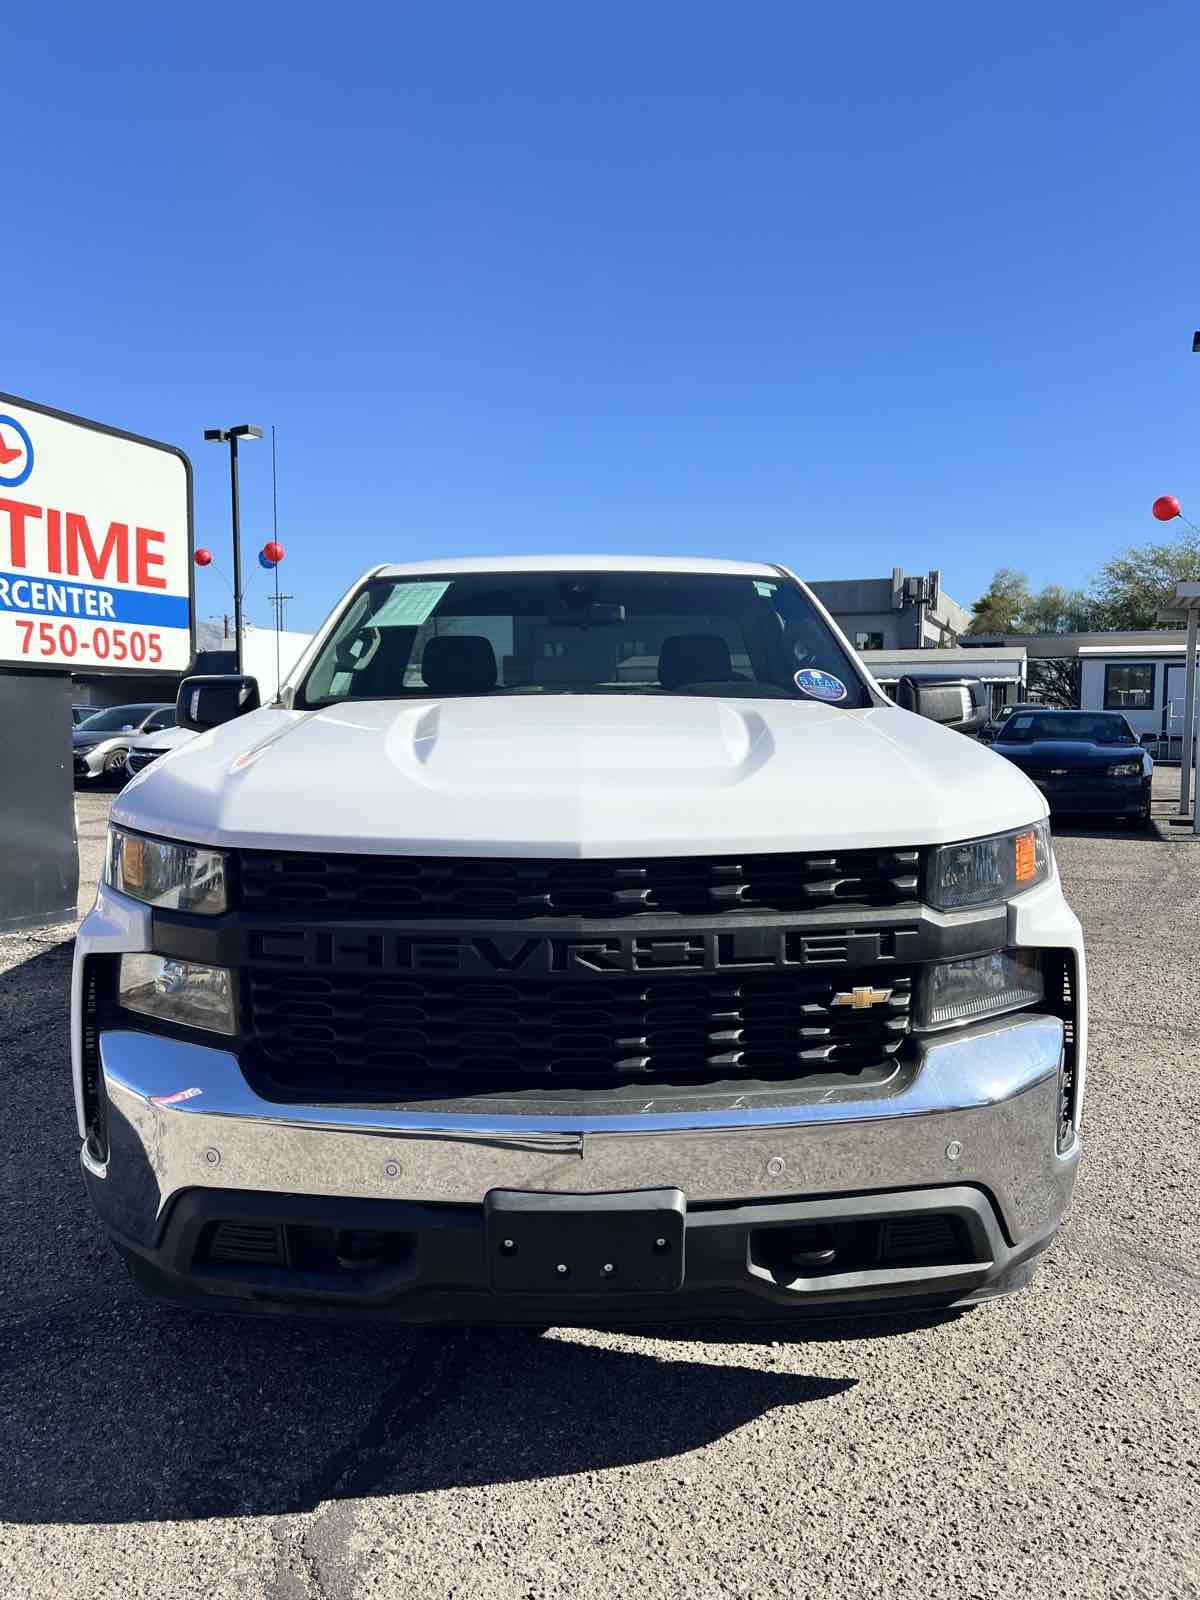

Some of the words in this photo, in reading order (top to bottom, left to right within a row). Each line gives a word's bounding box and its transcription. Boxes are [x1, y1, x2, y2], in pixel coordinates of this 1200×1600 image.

[0, 497, 167, 589] TIME
[15, 619, 162, 663] 750-0505
[249, 924, 919, 973] CHEVROLET
